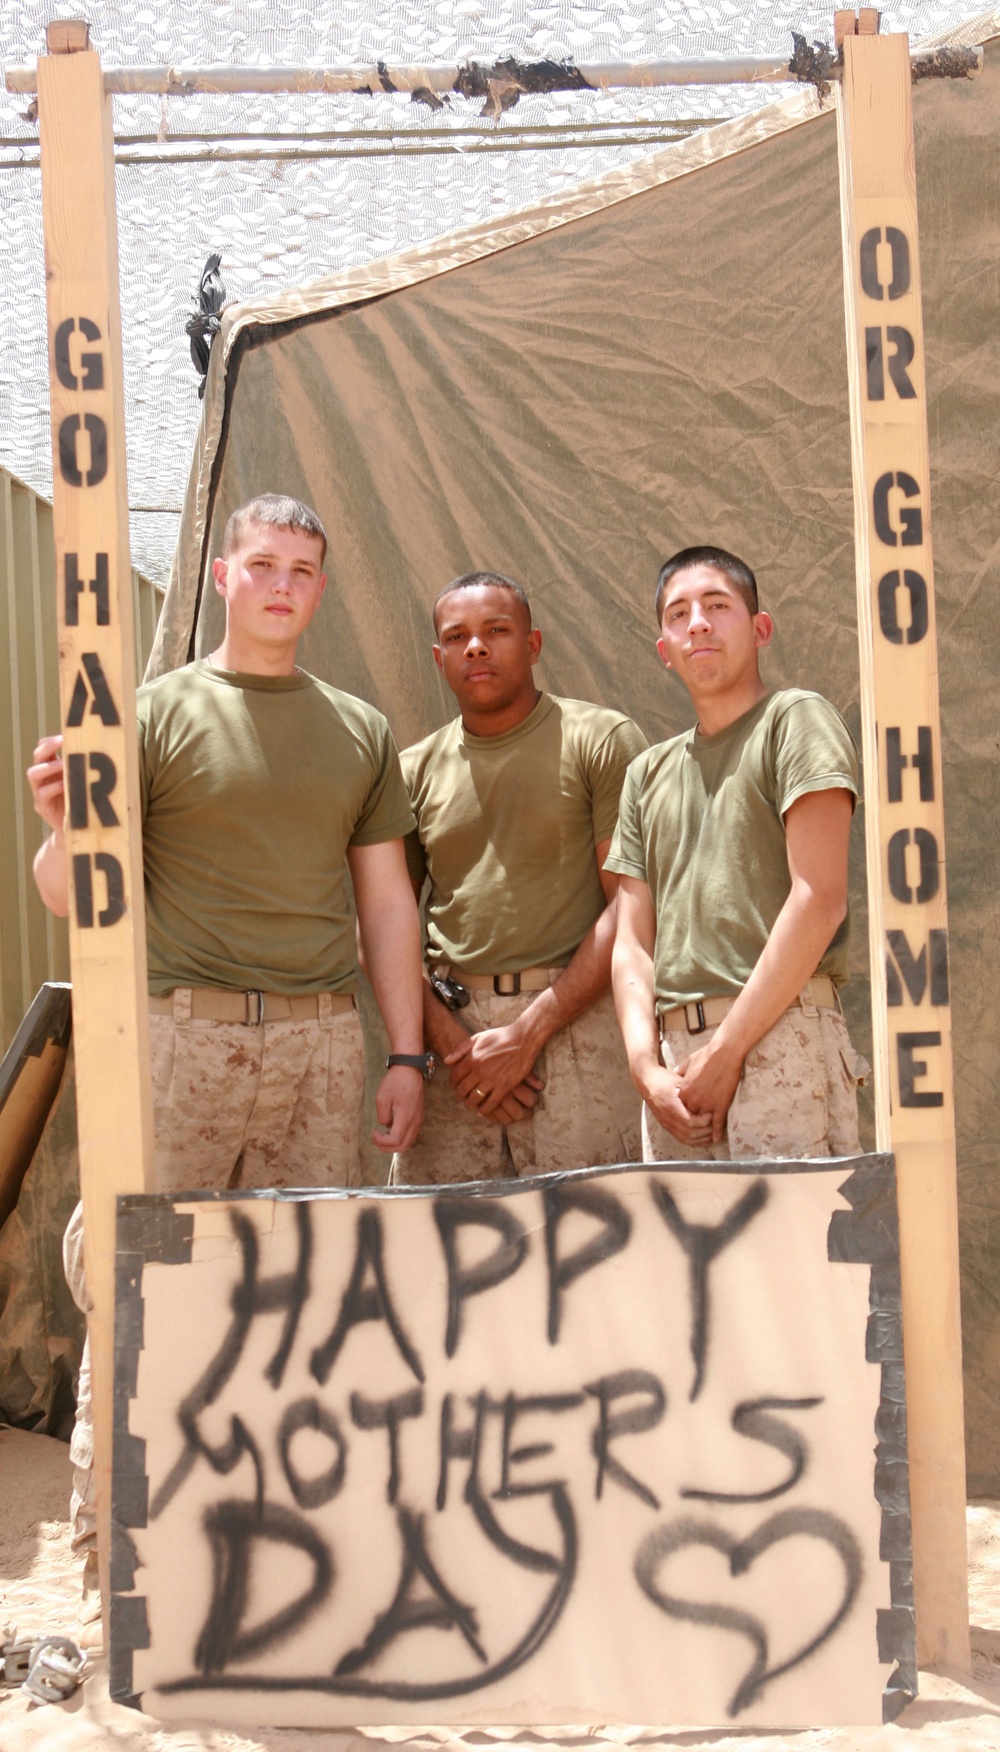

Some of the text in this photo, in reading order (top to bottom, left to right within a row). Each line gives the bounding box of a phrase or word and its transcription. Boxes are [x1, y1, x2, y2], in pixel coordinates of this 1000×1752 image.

[54, 316, 126, 929] GO HARD
[859, 226, 949, 1108] OR GO HOME
[198, 1178, 770, 1402] HAPPY
[155, 1484, 578, 1700] DAY
